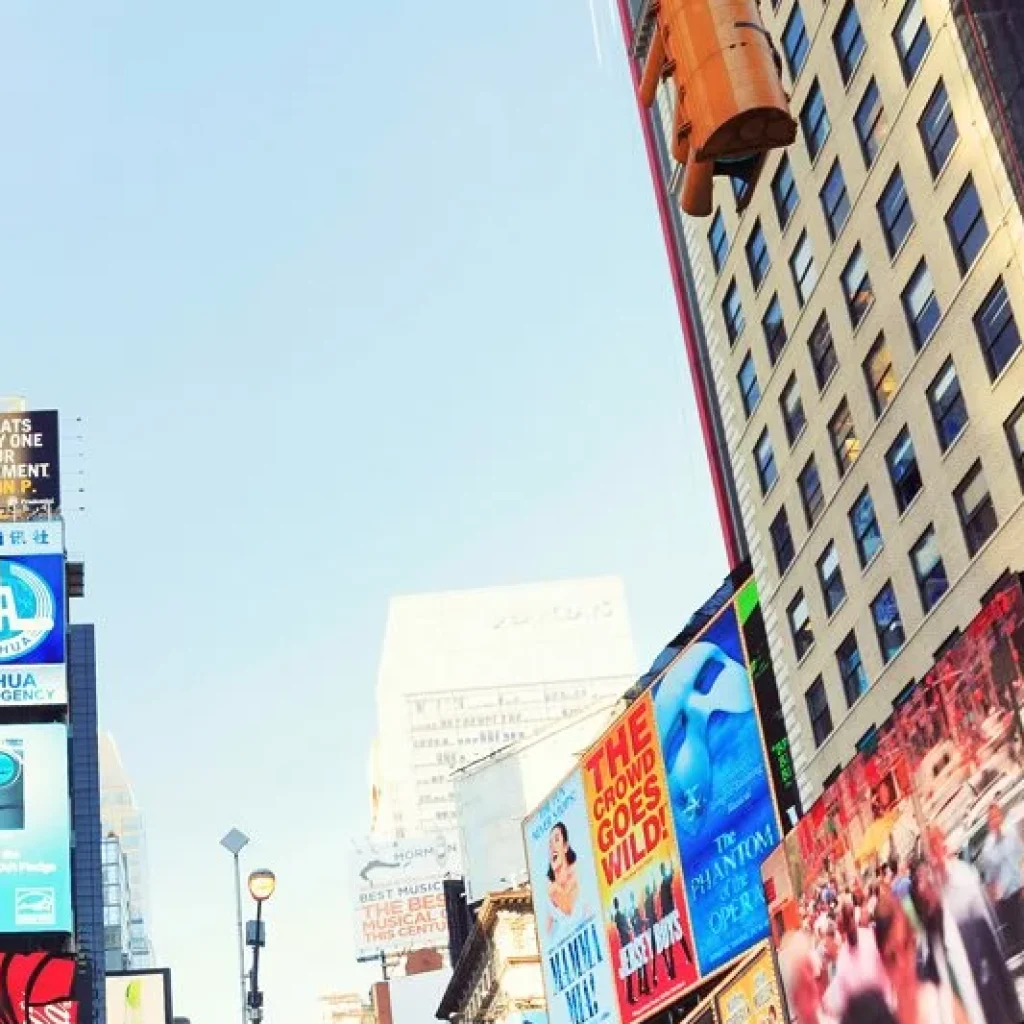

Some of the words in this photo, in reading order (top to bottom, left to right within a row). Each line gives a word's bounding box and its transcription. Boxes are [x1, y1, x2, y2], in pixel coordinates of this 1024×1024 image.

[10, 432, 43, 447] ONE
[21, 479, 37, 493] P.
[585, 702, 652, 794] THE
[593, 750, 656, 820] CROWD
[597, 775, 661, 853] GOES
[601, 808, 669, 886] WILD!
[691, 825, 774, 899] PHANTOM
[363, 912, 437, 931] MUSICAL
[365, 901, 403, 919] THE
